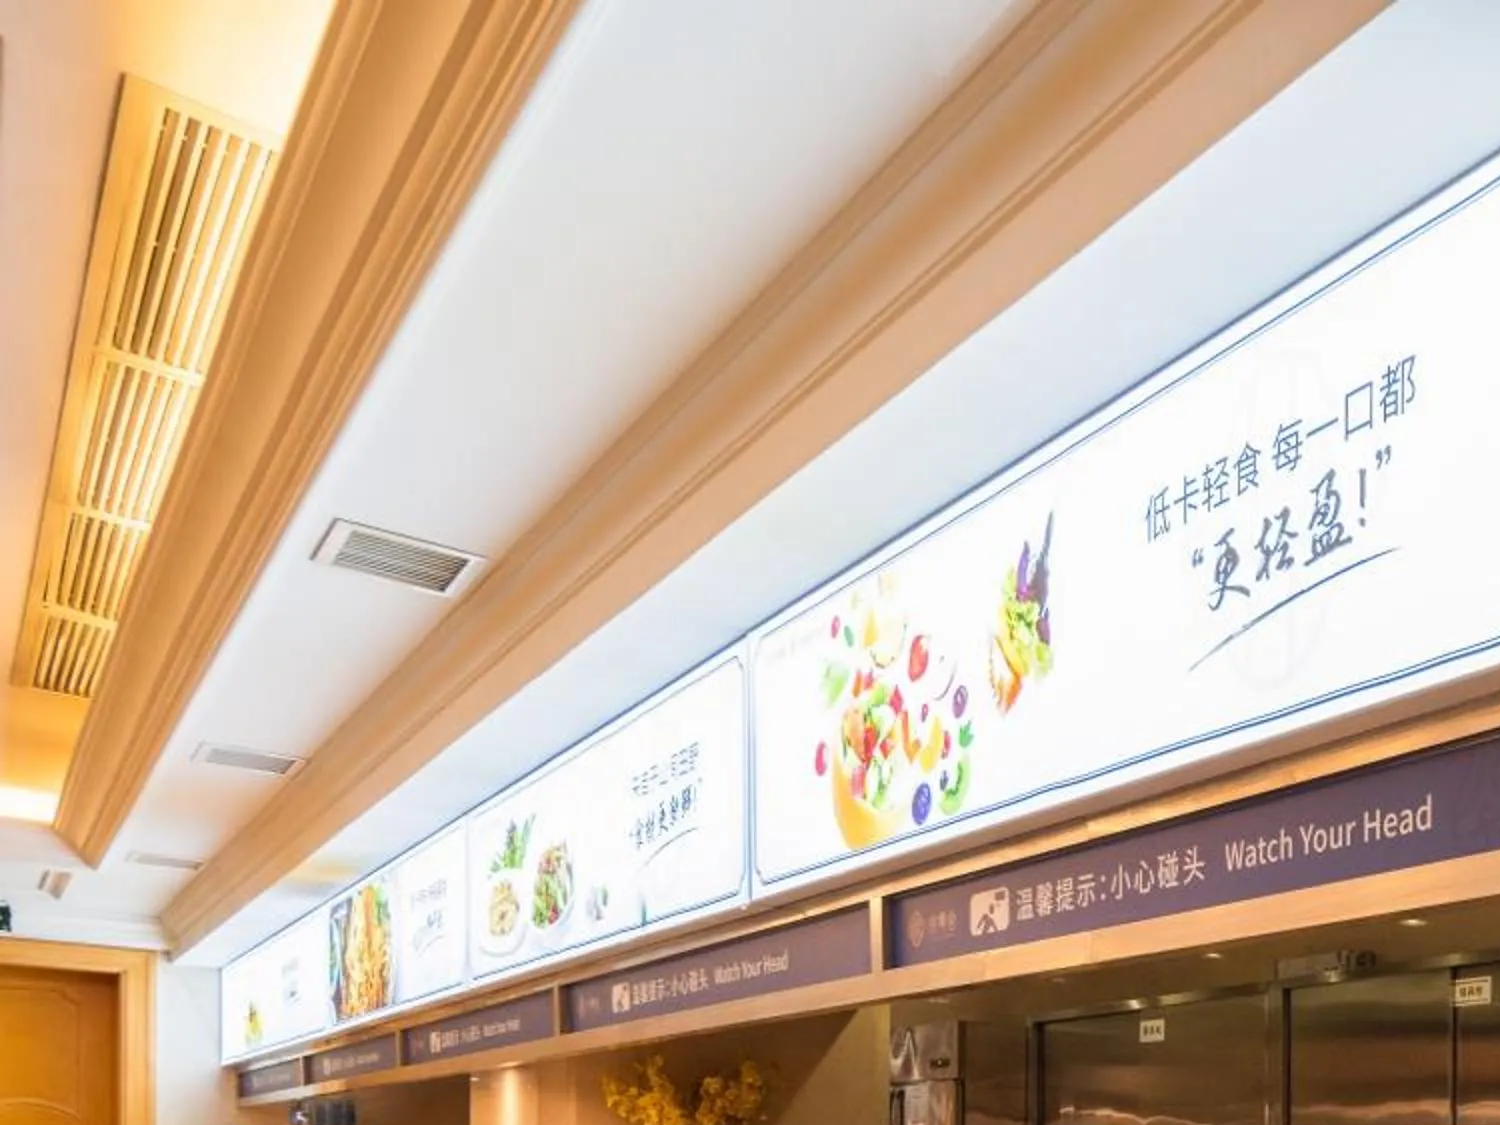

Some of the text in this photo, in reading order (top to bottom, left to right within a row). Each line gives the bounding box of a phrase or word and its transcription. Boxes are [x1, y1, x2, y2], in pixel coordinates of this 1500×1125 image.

[1145, 354, 1416, 543] 低卡轻食 每一口都
[1016, 793, 1433, 921] 温馨提示:小心碰头 Watch Your Head
